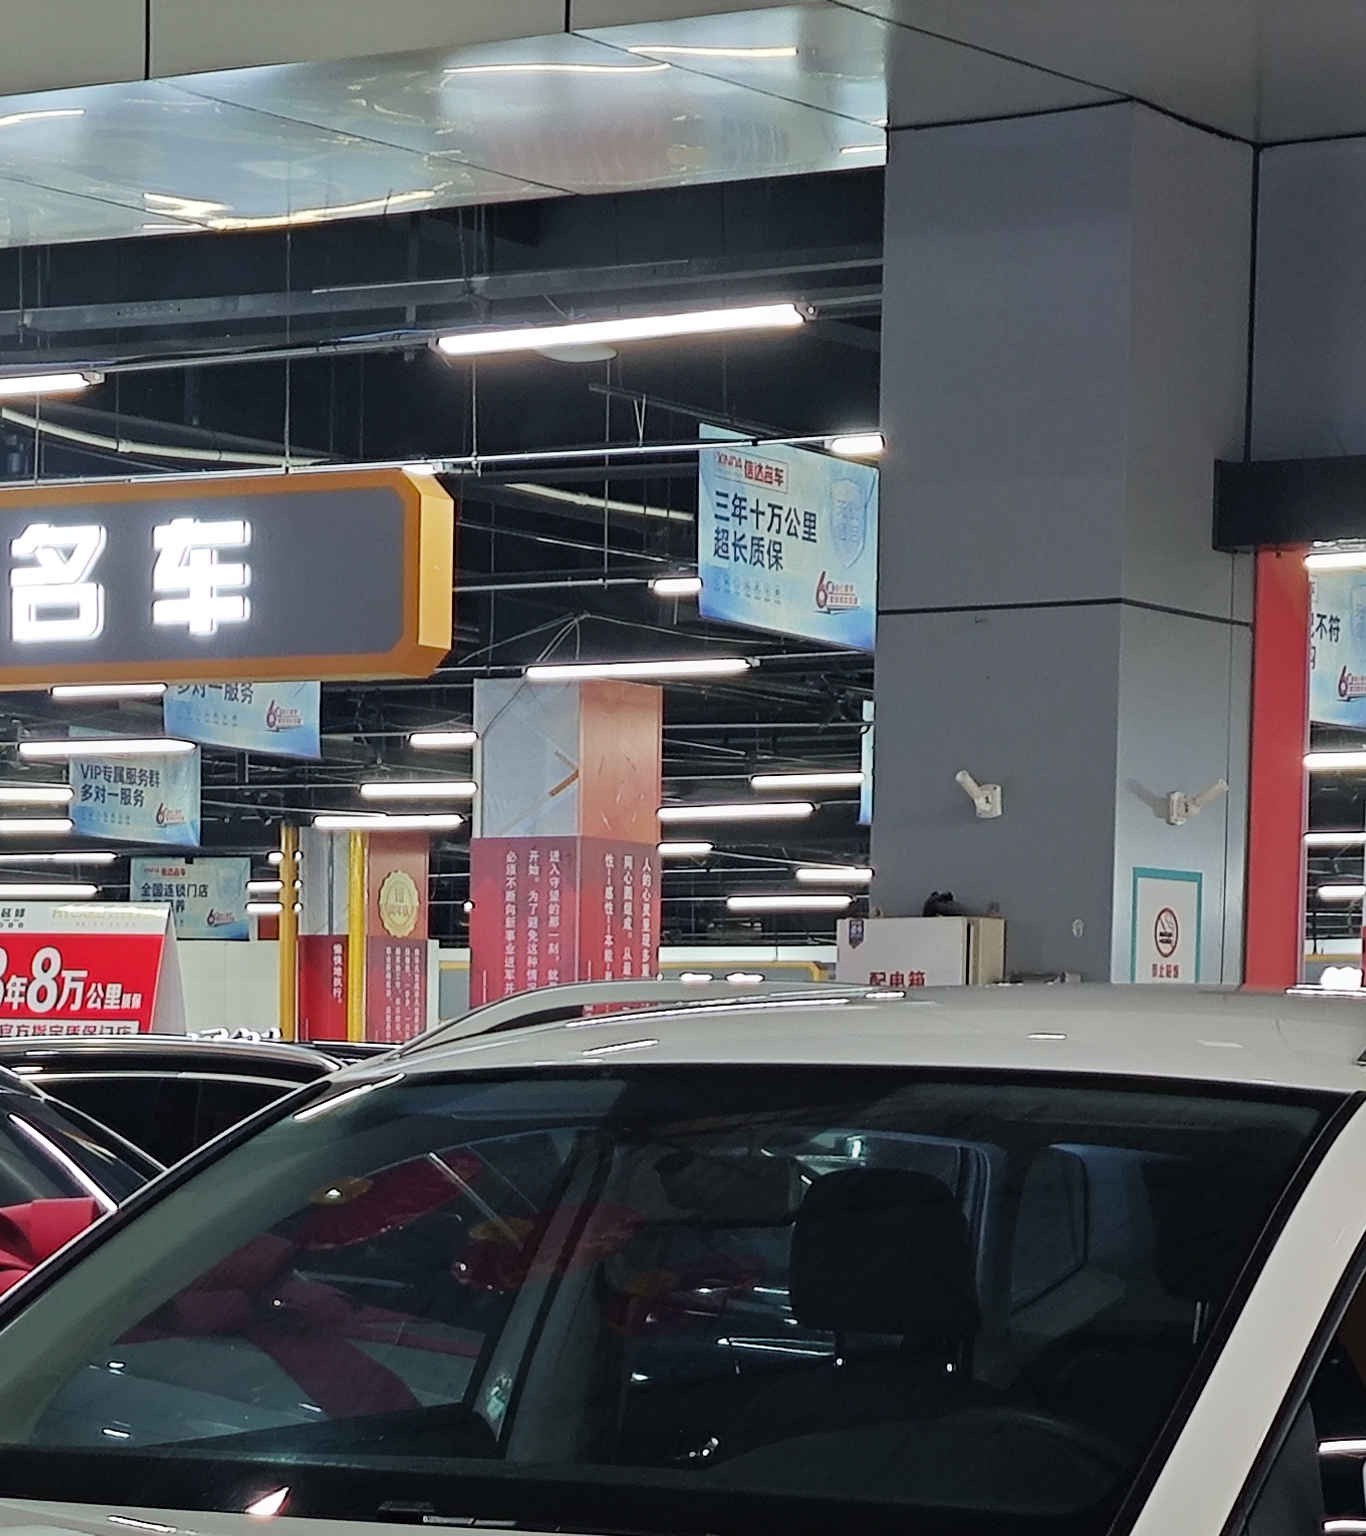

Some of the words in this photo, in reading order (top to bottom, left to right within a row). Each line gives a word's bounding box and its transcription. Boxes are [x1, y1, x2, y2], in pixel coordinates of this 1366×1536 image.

[744, 460, 784, 486] 信达名车
[714, 491, 818, 543] 三年十万公里
[713, 526, 784, 571] 超长质保
[81, 764, 160, 788] VIP专属服务群
[81, 785, 145, 808] 多对一服务
[140, 883, 209, 898] 全国连锁门店
[623, 856, 634, 979] 同心圆组成。从最
[869, 971, 926, 986] 配电箱
